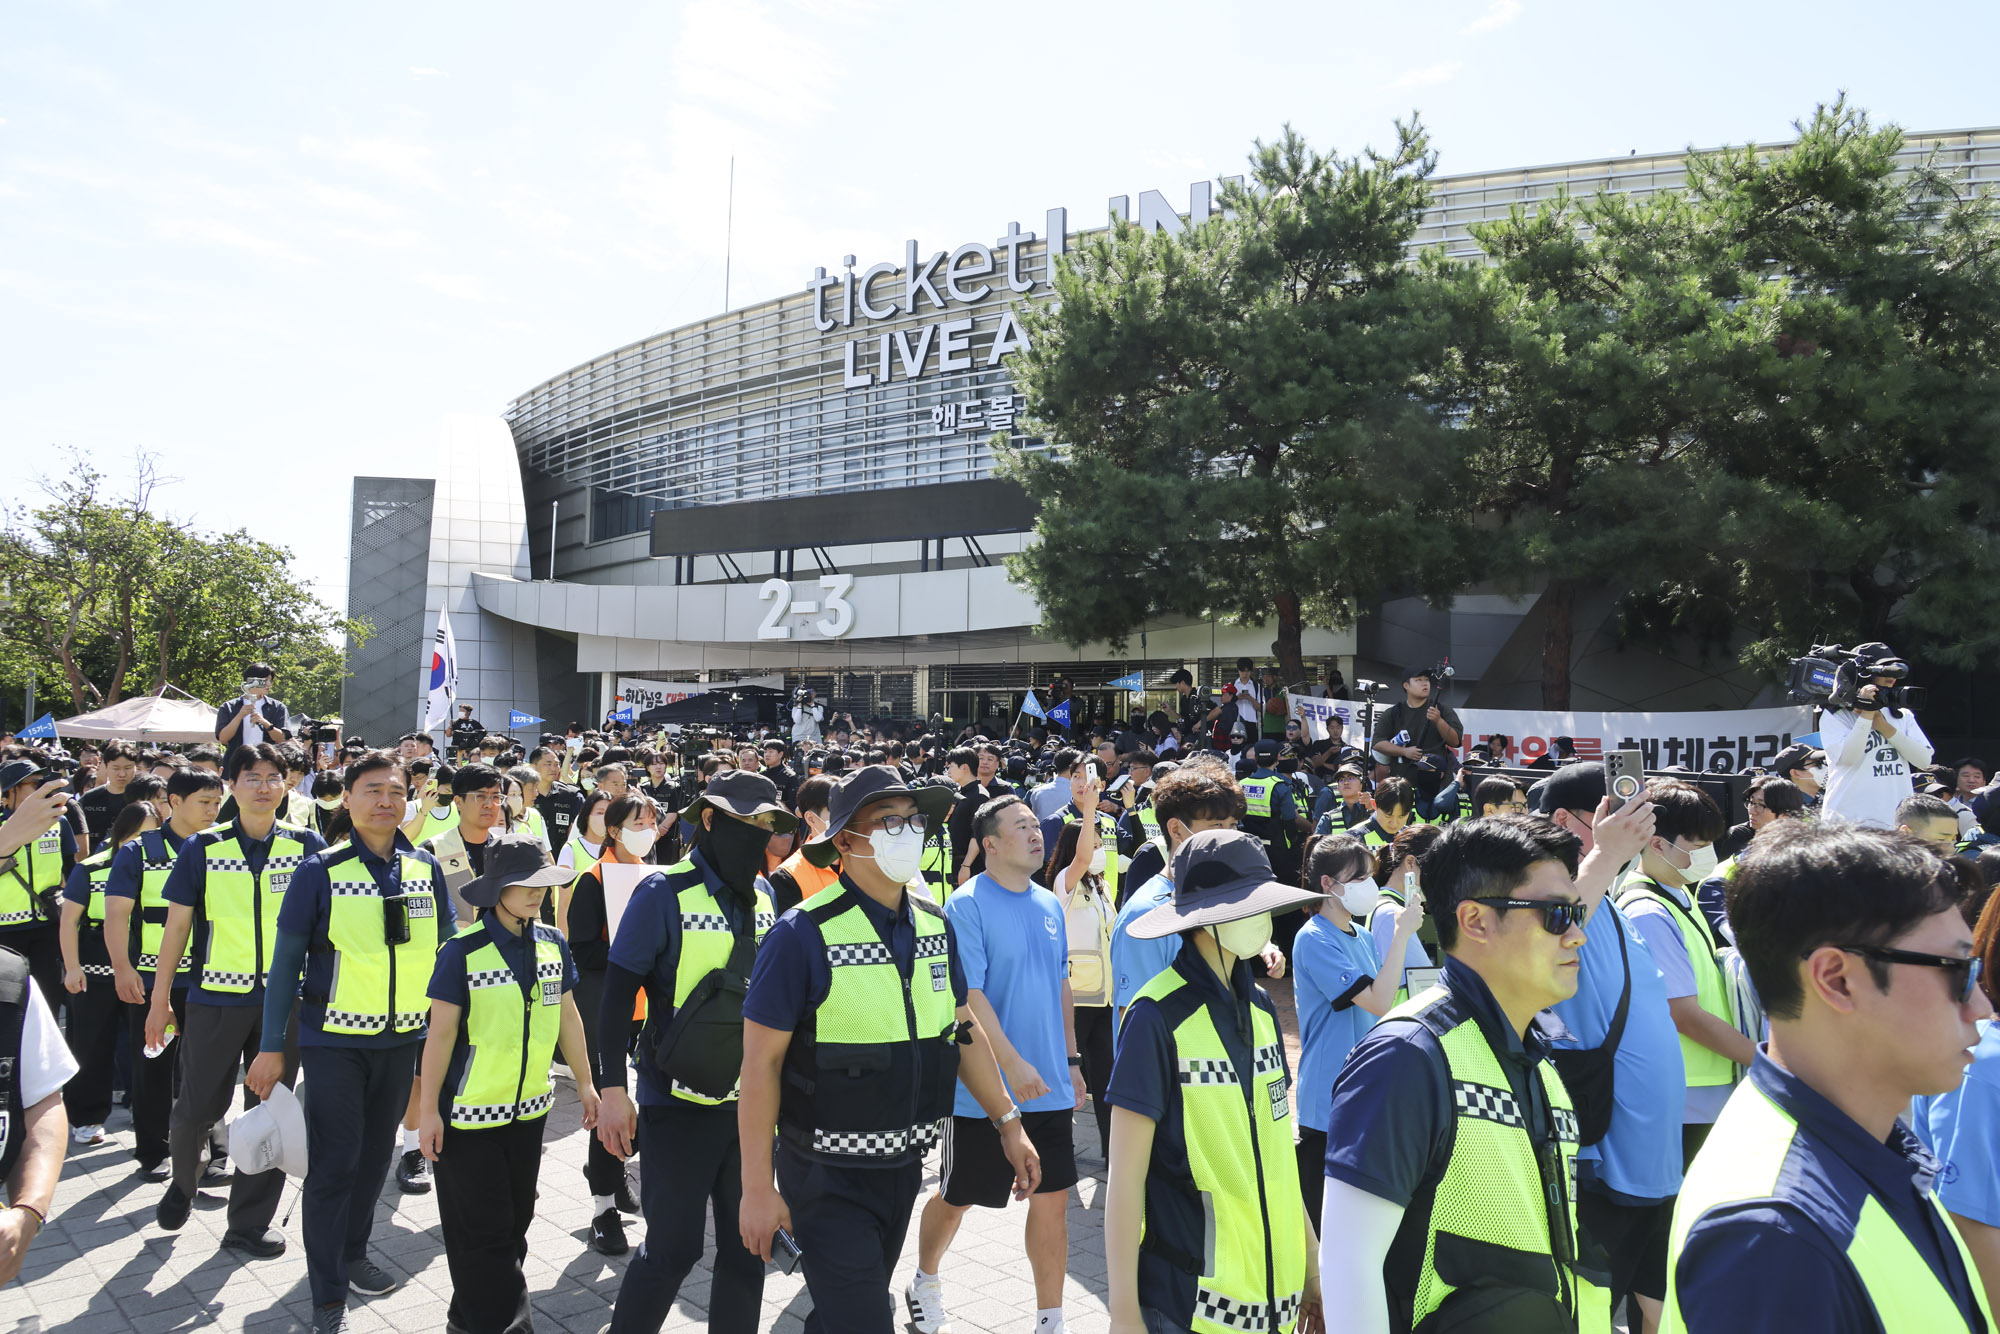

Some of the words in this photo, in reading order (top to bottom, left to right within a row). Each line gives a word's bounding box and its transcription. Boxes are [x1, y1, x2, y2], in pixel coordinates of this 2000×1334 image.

[843, 318, 974, 389] LIVE
[757, 573, 855, 640] 2-3
[512, 716, 534, 724] 12기-3
[28, 722, 53, 736] 15기-3
[1880, 749, 1893, 761] 76
[272, 874, 292, 885] 대화경
